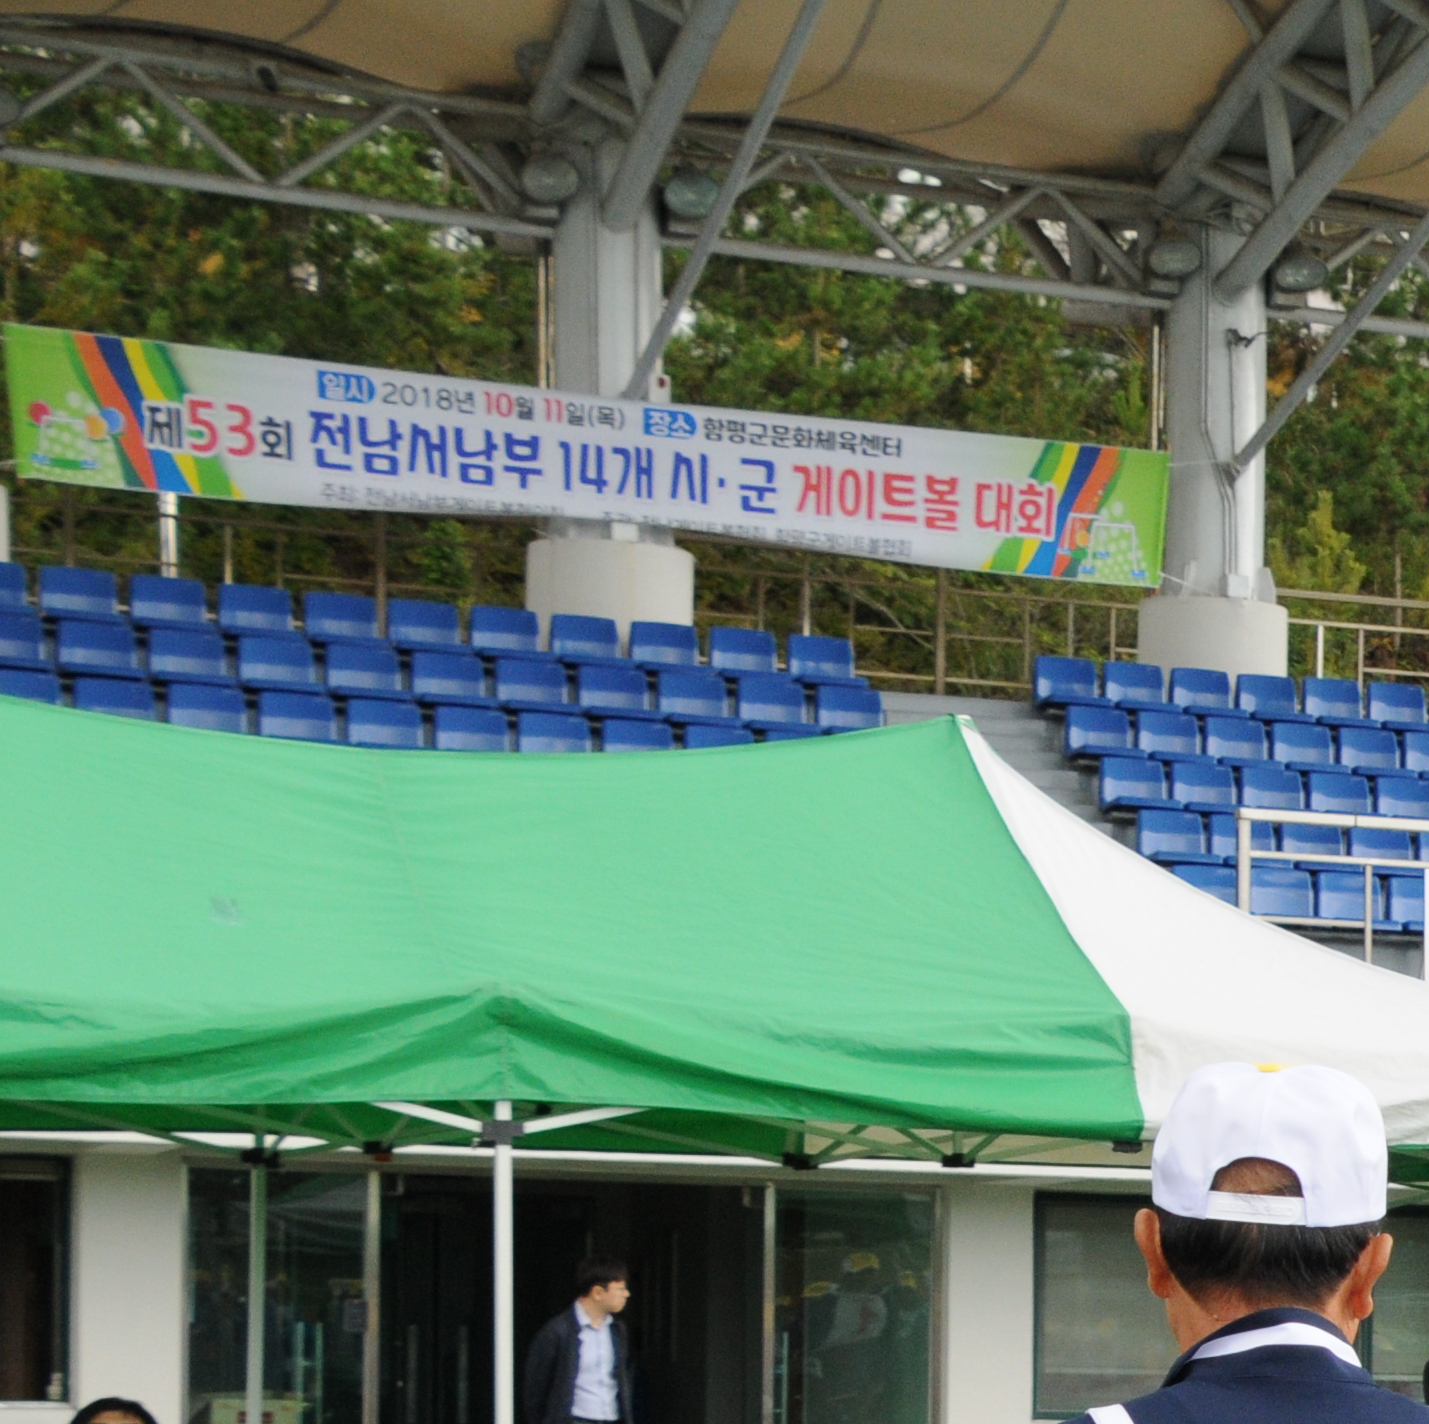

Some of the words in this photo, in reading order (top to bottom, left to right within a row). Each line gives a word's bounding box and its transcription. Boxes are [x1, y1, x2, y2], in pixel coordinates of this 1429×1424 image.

[146, 398, 294, 462] 제53회
[309, 409, 544, 490] 전남서남부
[558, 440, 654, 500] 14개
[670, 450, 777, 515] 시·군
[792, 464, 961, 533] 게이트볼
[973, 480, 1056, 538] 대회
[322, 372, 371, 403] 일시
[380, 381, 476, 415] 2018년
[483, 389, 535, 421] 10월
[542, 397, 626, 431] 11일(목)
[648, 409, 695, 438] 장소
[703, 417, 903, 458] 함평군문화체육센터
